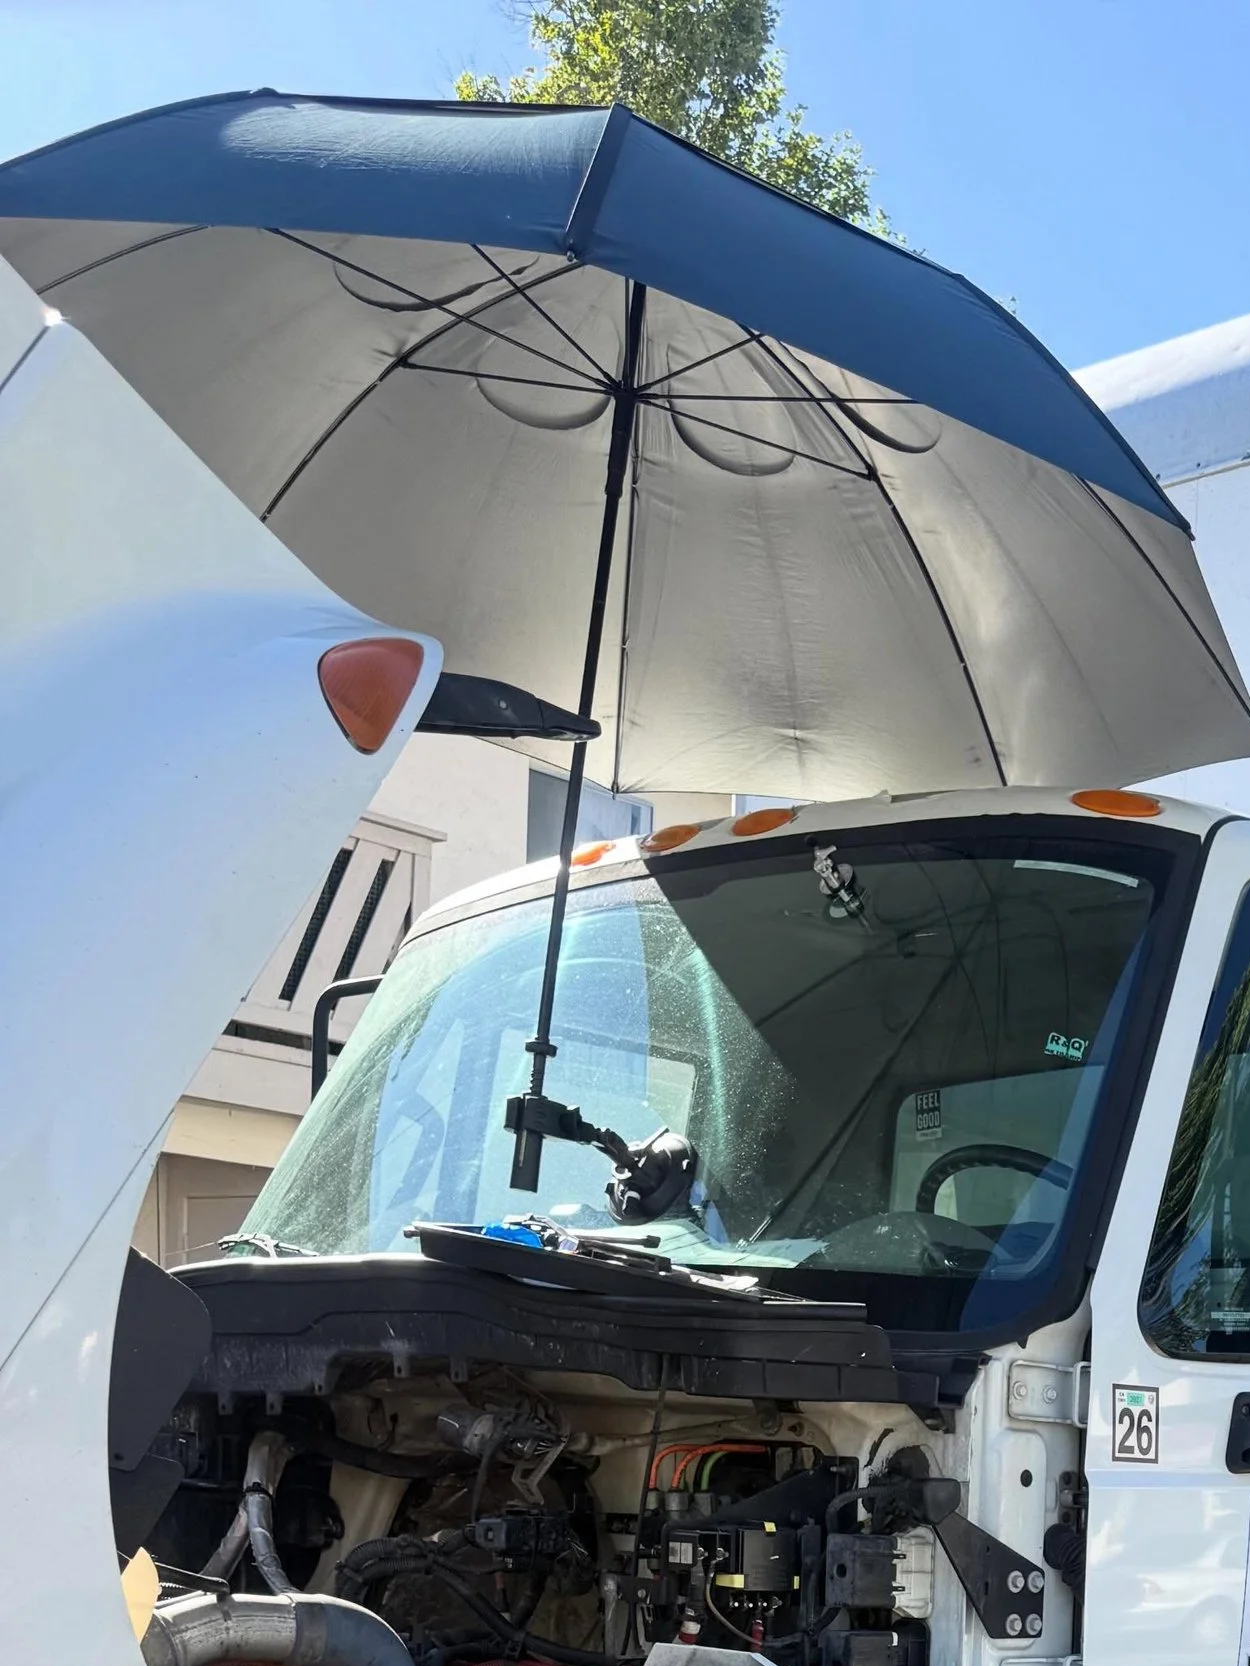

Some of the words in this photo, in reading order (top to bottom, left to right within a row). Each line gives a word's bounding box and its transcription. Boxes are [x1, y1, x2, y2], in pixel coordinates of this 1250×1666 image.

[917, 1092, 940, 1110] FEEL
[917, 1111, 940, 1129] GOOD
[1118, 1407, 1153, 1456] 26
